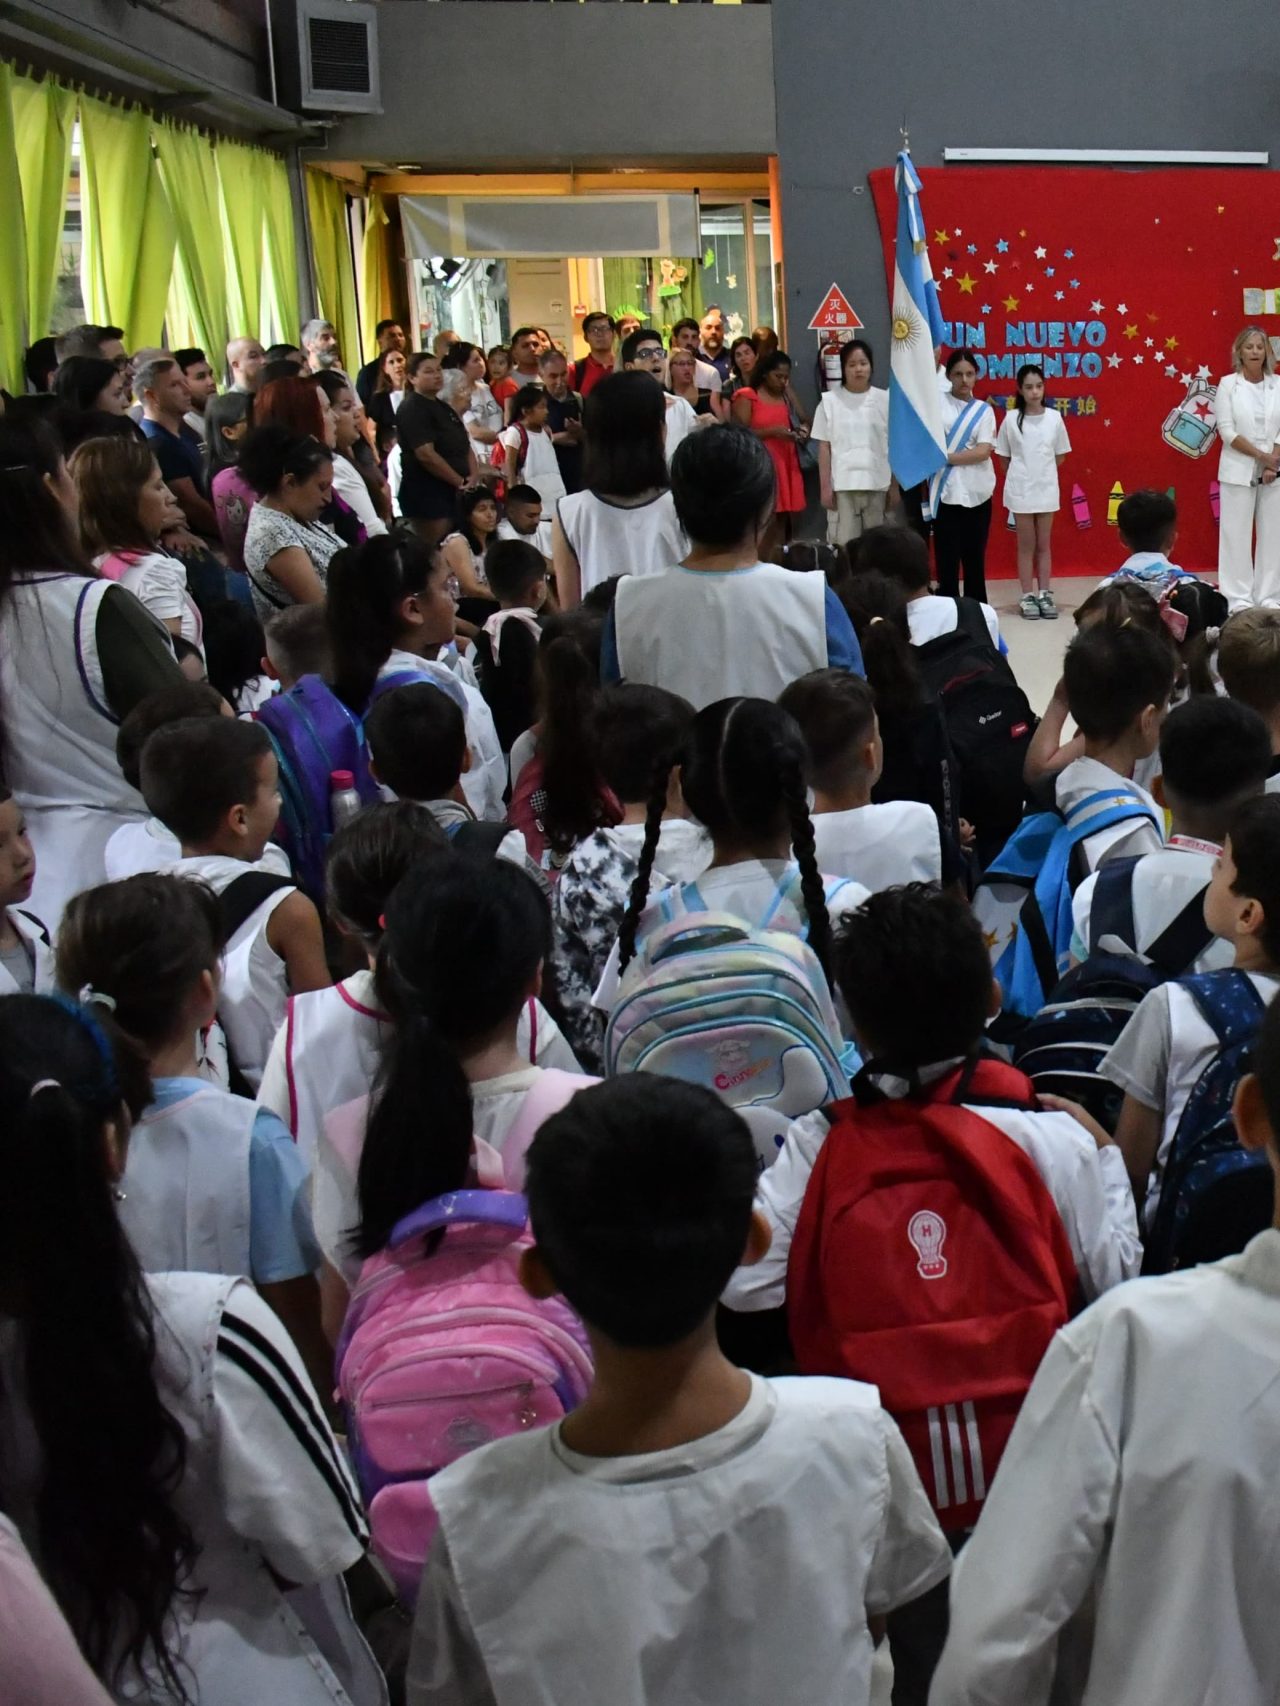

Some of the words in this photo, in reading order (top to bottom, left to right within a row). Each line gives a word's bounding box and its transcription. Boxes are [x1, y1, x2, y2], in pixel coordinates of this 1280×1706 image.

[943, 321, 986, 348] UN
[1006, 321, 1107, 348] NUEVO
[973, 352, 1103, 380] OMINZO
[921, 1224, 932, 1238] H
